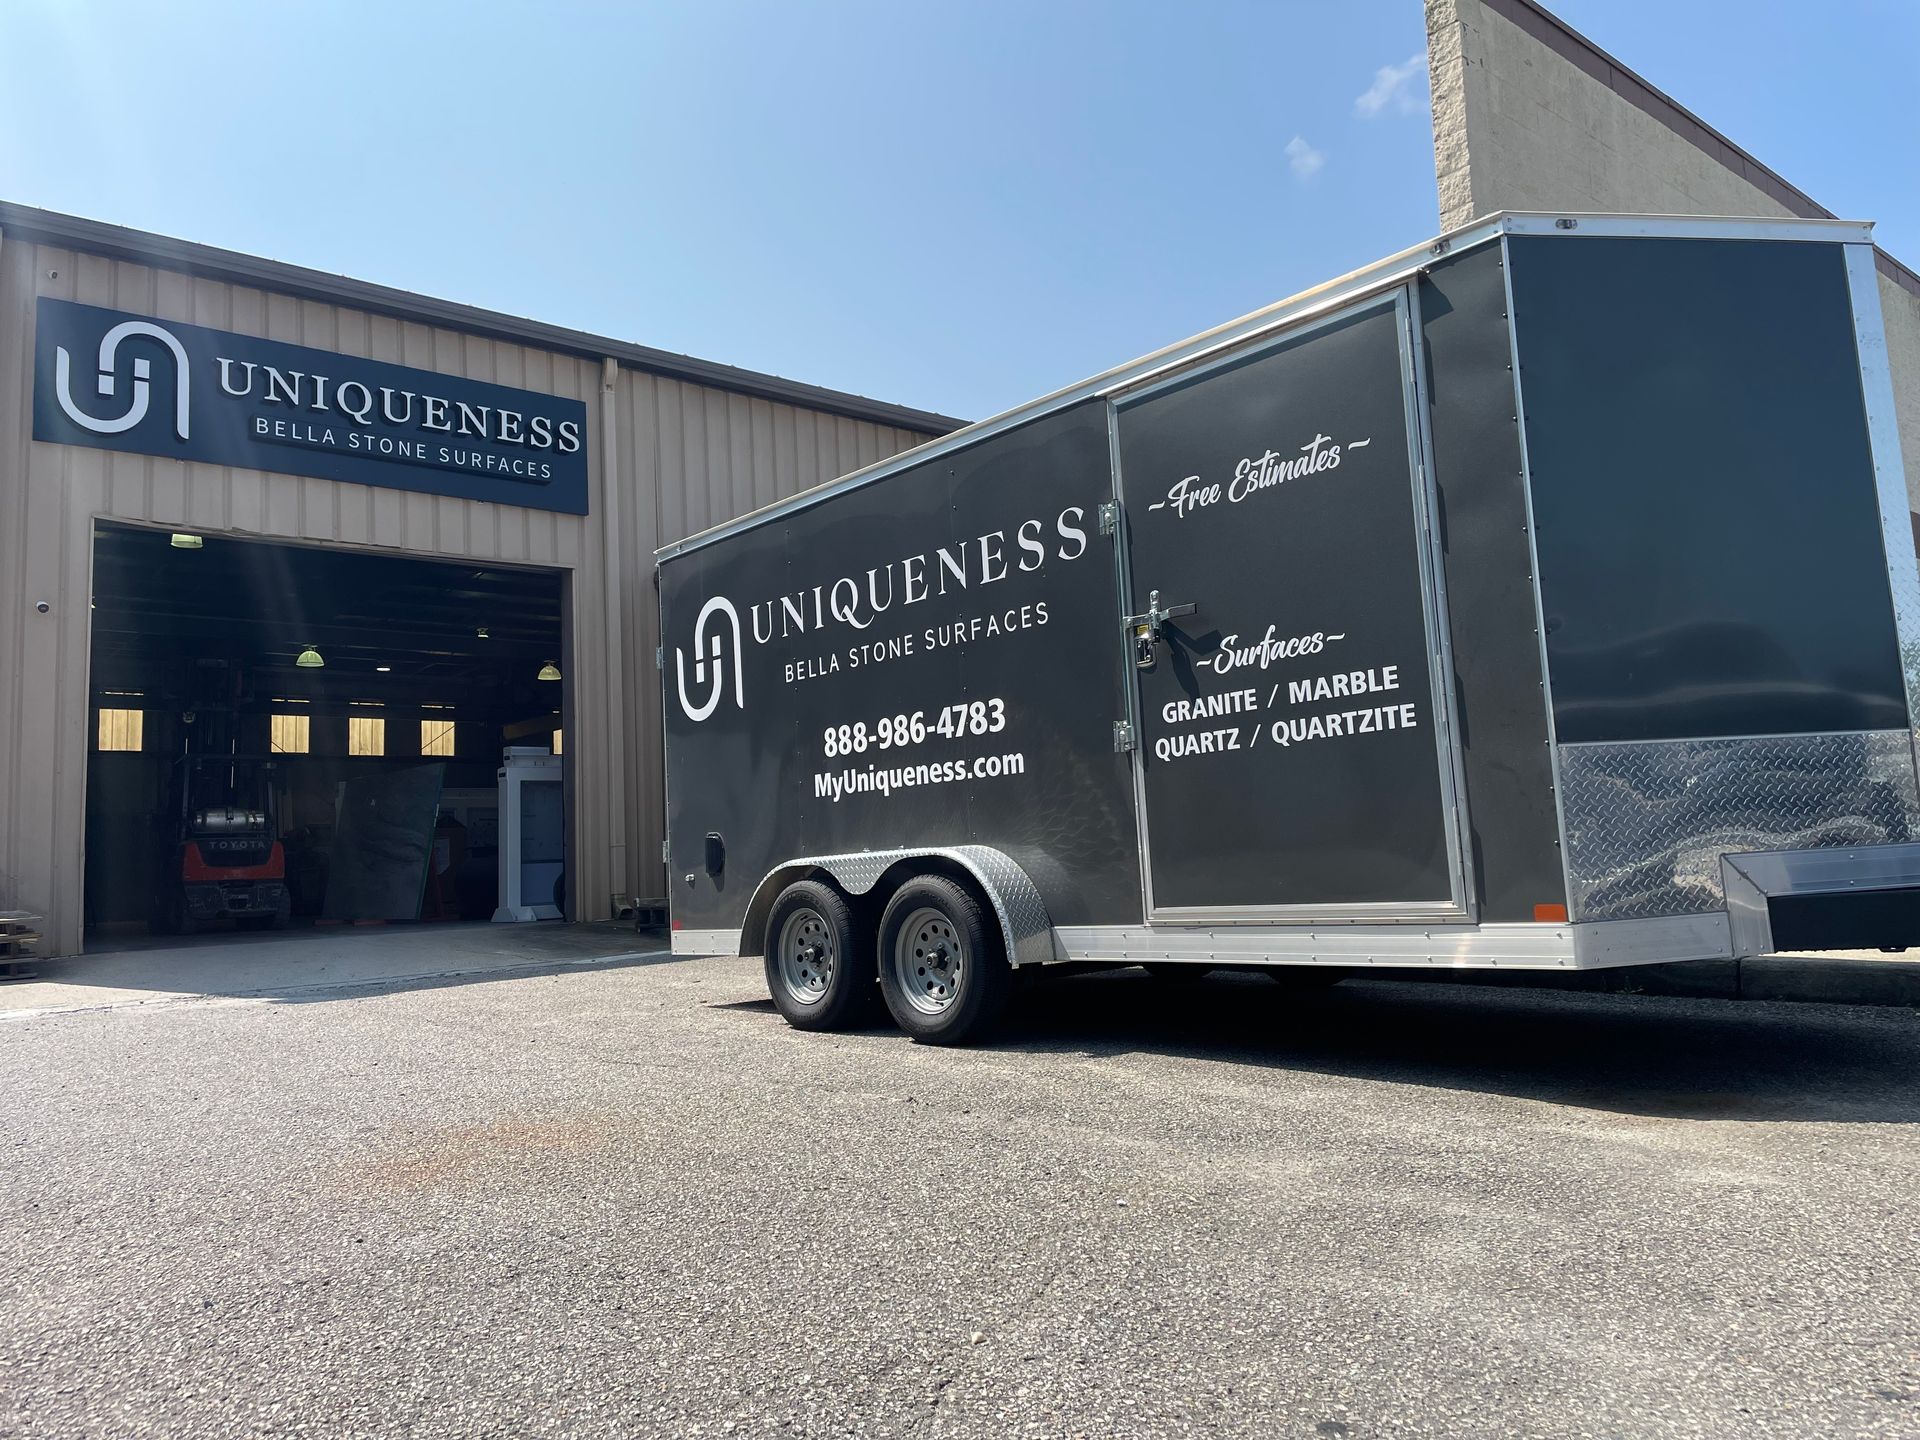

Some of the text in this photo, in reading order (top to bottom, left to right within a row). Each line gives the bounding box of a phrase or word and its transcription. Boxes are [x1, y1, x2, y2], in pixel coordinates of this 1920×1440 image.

[215, 356, 581, 453] UNIQUENESS
[255, 417, 552, 480] BELLA STONE SURFACES
[749, 505, 1088, 645] UNIQUENESS
[784, 600, 1050, 684] BELLA STONE SURFACES
[1161, 687, 1258, 725] GRANITE
[1288, 664, 1400, 706] MARBLE
[823, 697, 1007, 759] 888-986-4783
[1154, 727, 1241, 762] QUARTZ
[1271, 703, 1418, 747] QUARTZITE
[813, 751, 1026, 803] MyUniqueness.com
[208, 840, 267, 849] TOYOTA
